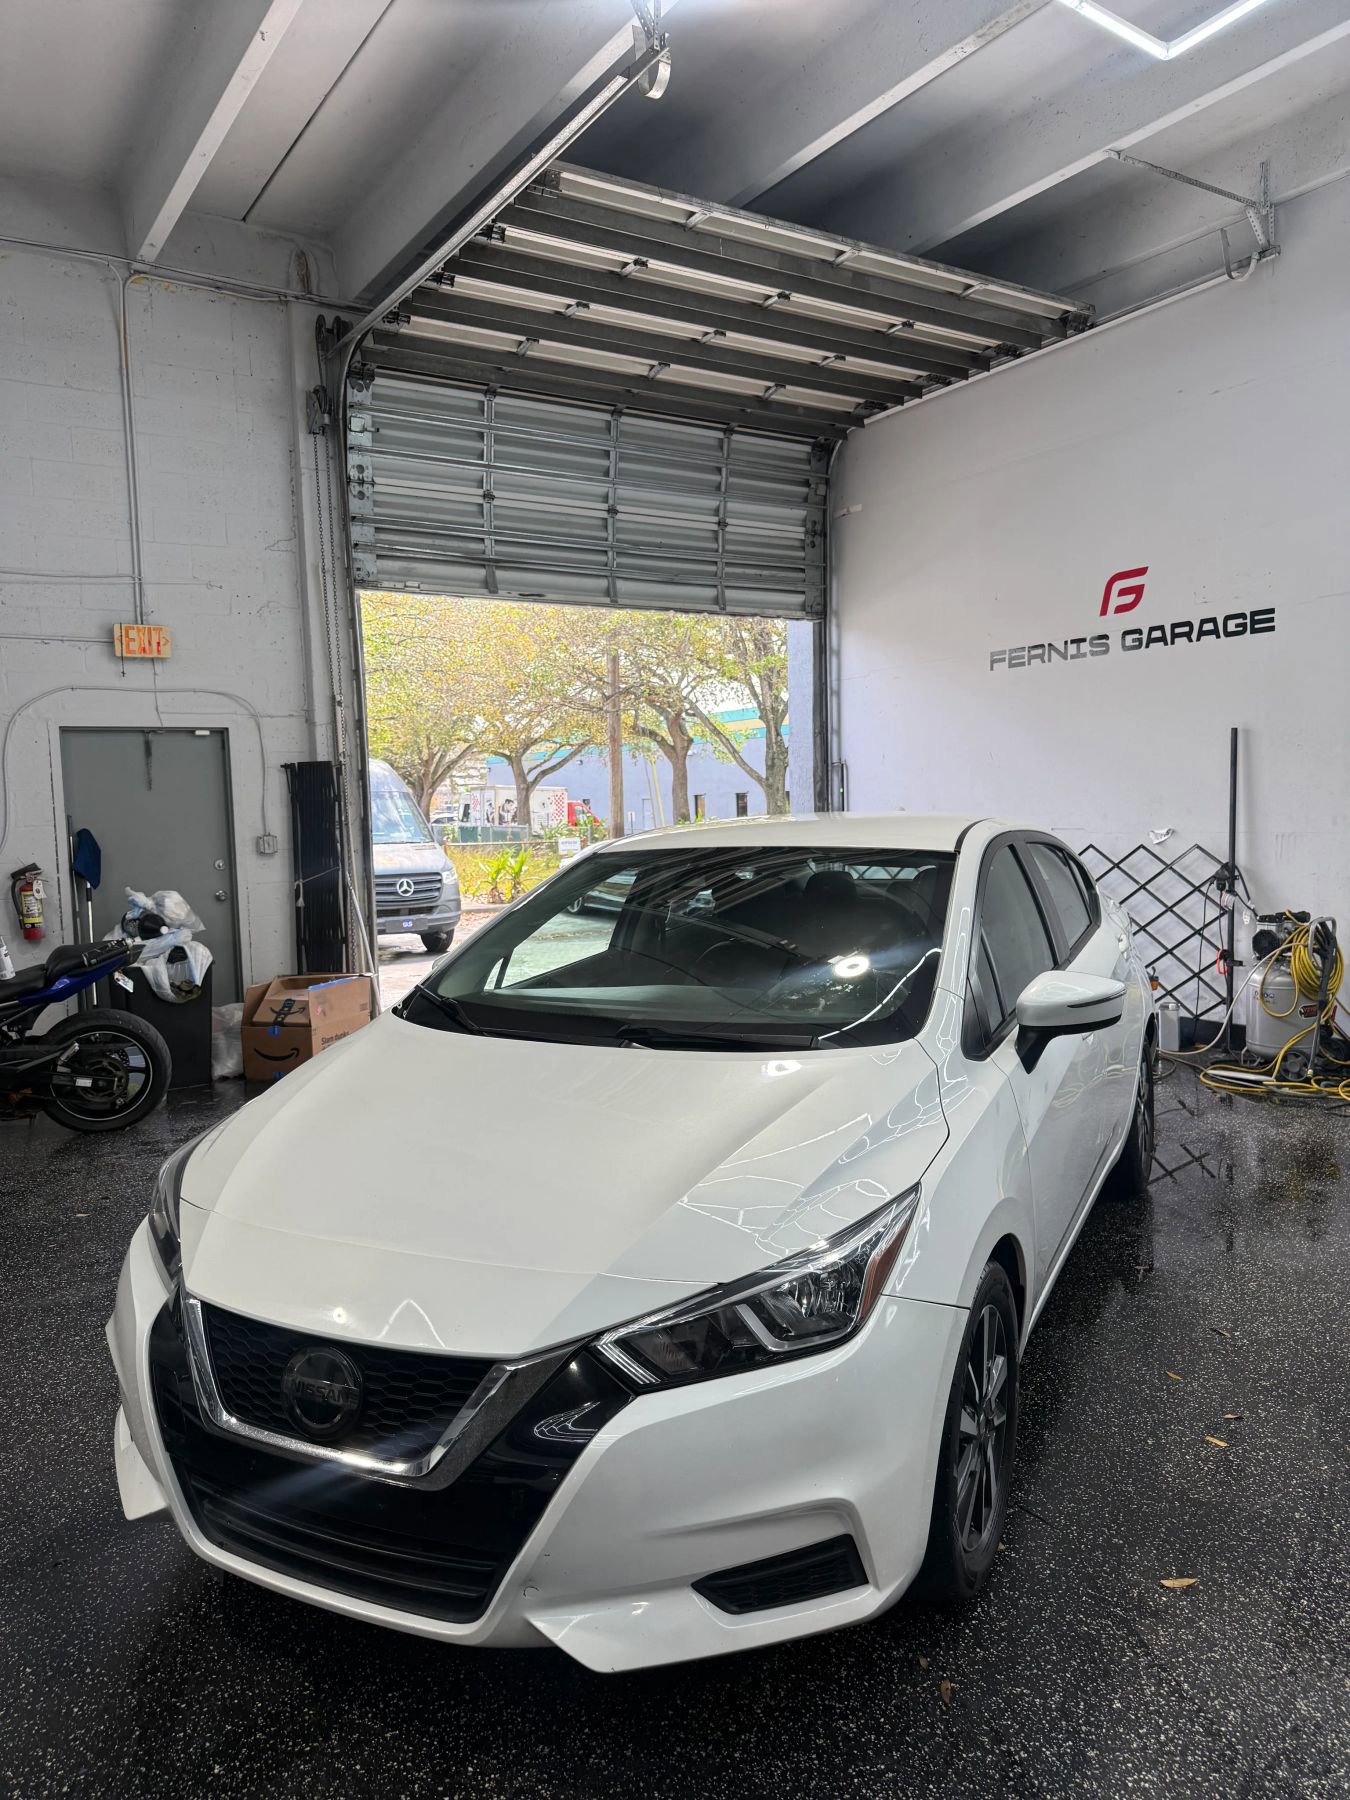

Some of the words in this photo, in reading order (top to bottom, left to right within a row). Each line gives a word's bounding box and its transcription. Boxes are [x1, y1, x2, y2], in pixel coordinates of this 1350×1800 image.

[124, 625, 163, 655] EXIT
[989, 634, 1110, 671] FERNIS
[1121, 607, 1276, 651] GARAGE
[290, 1377, 353, 1405] NISSAN
